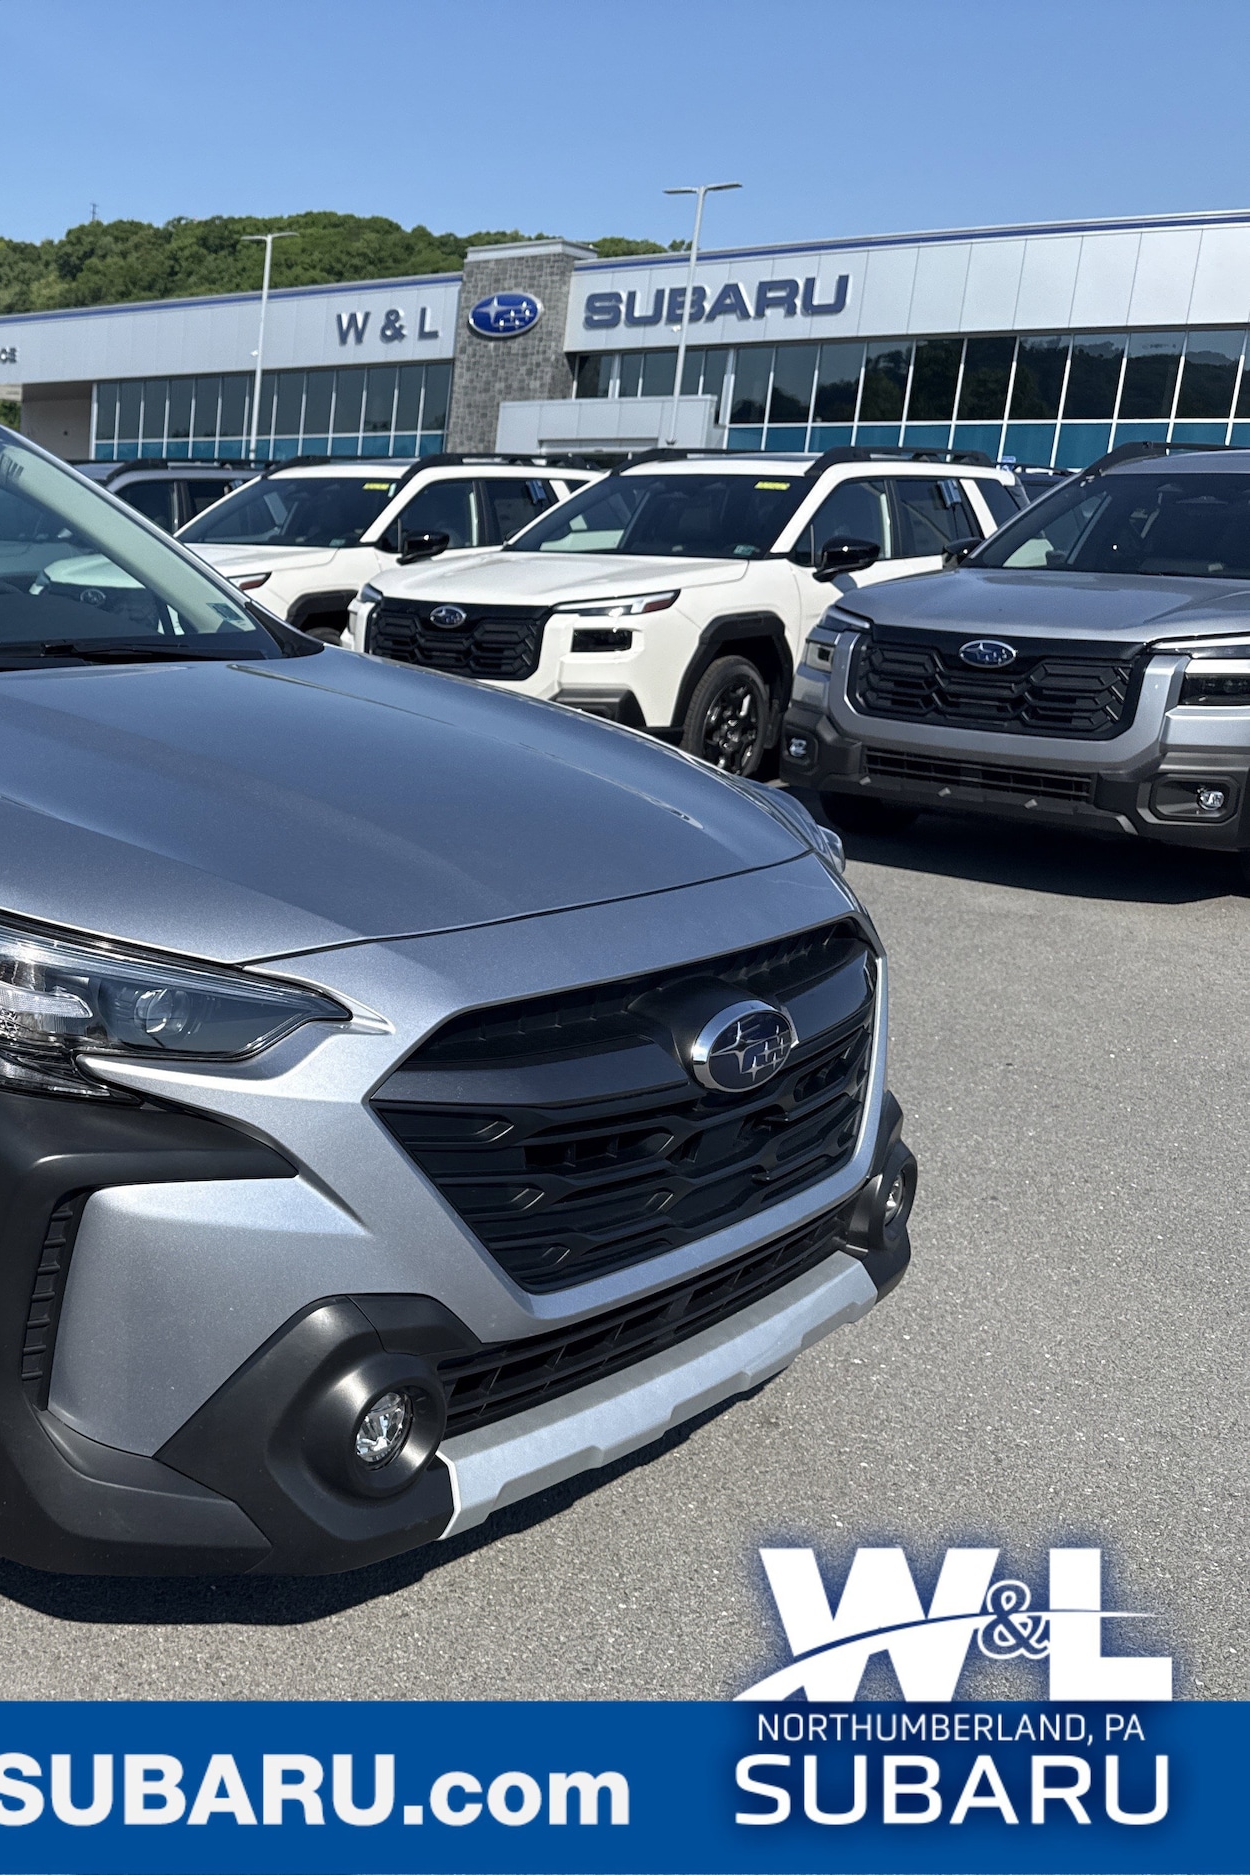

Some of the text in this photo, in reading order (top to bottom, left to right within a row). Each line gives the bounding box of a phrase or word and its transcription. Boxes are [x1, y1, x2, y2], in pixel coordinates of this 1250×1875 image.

[336, 306, 440, 346] W & L
[583, 274, 851, 331] SUBARU
